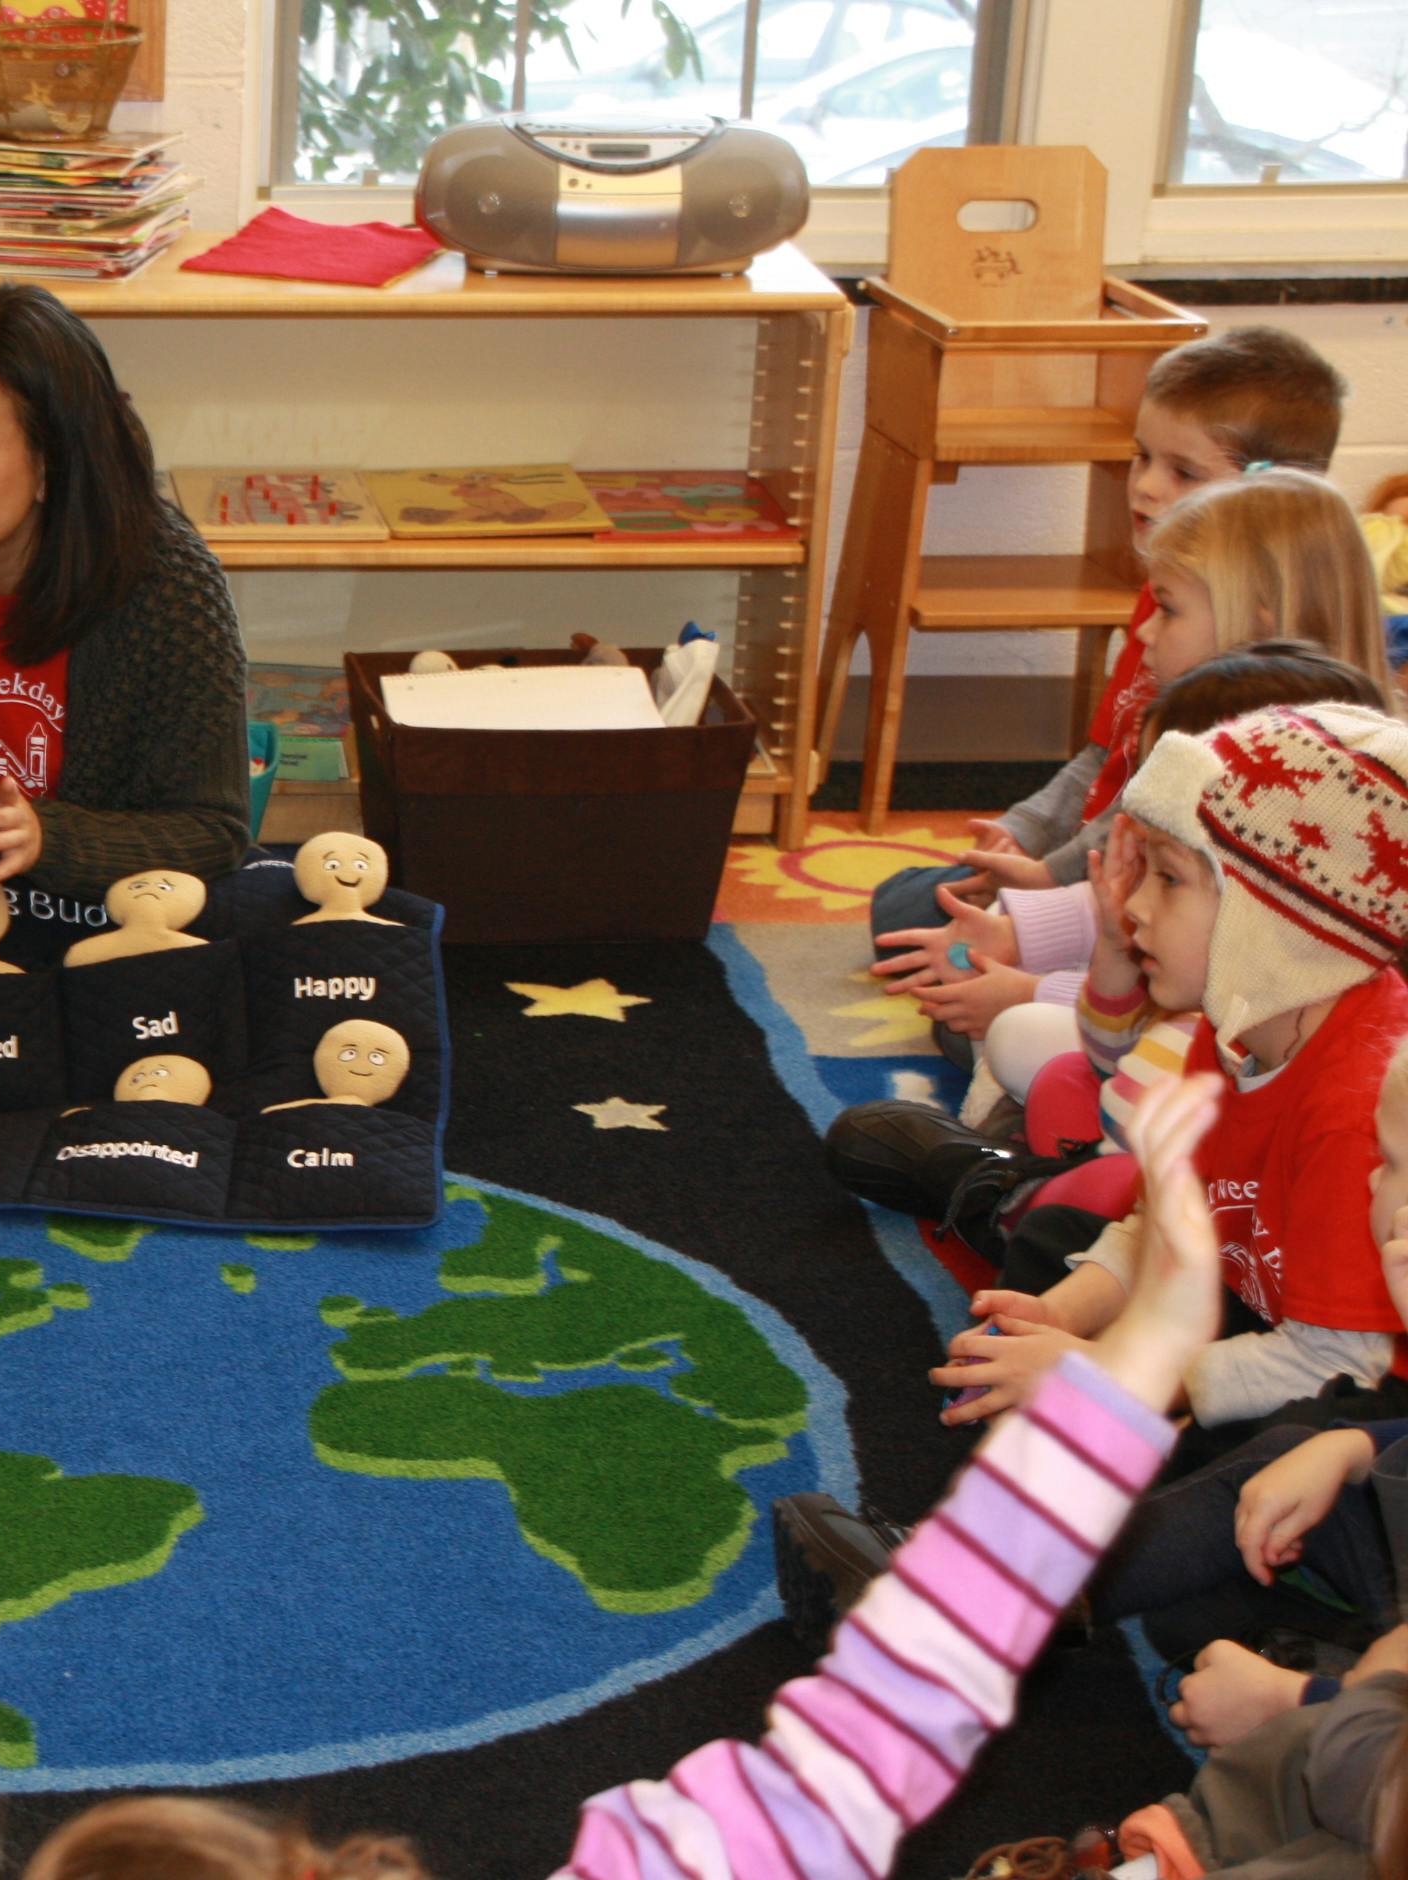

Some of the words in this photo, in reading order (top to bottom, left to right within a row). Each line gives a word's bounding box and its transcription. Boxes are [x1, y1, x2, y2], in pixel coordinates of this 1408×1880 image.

[294, 976, 376, 1001] Happy
[132, 1011, 179, 1040] Sad
[55, 1140, 199, 1169] Disappointed
[286, 1147, 354, 1169] Calm
